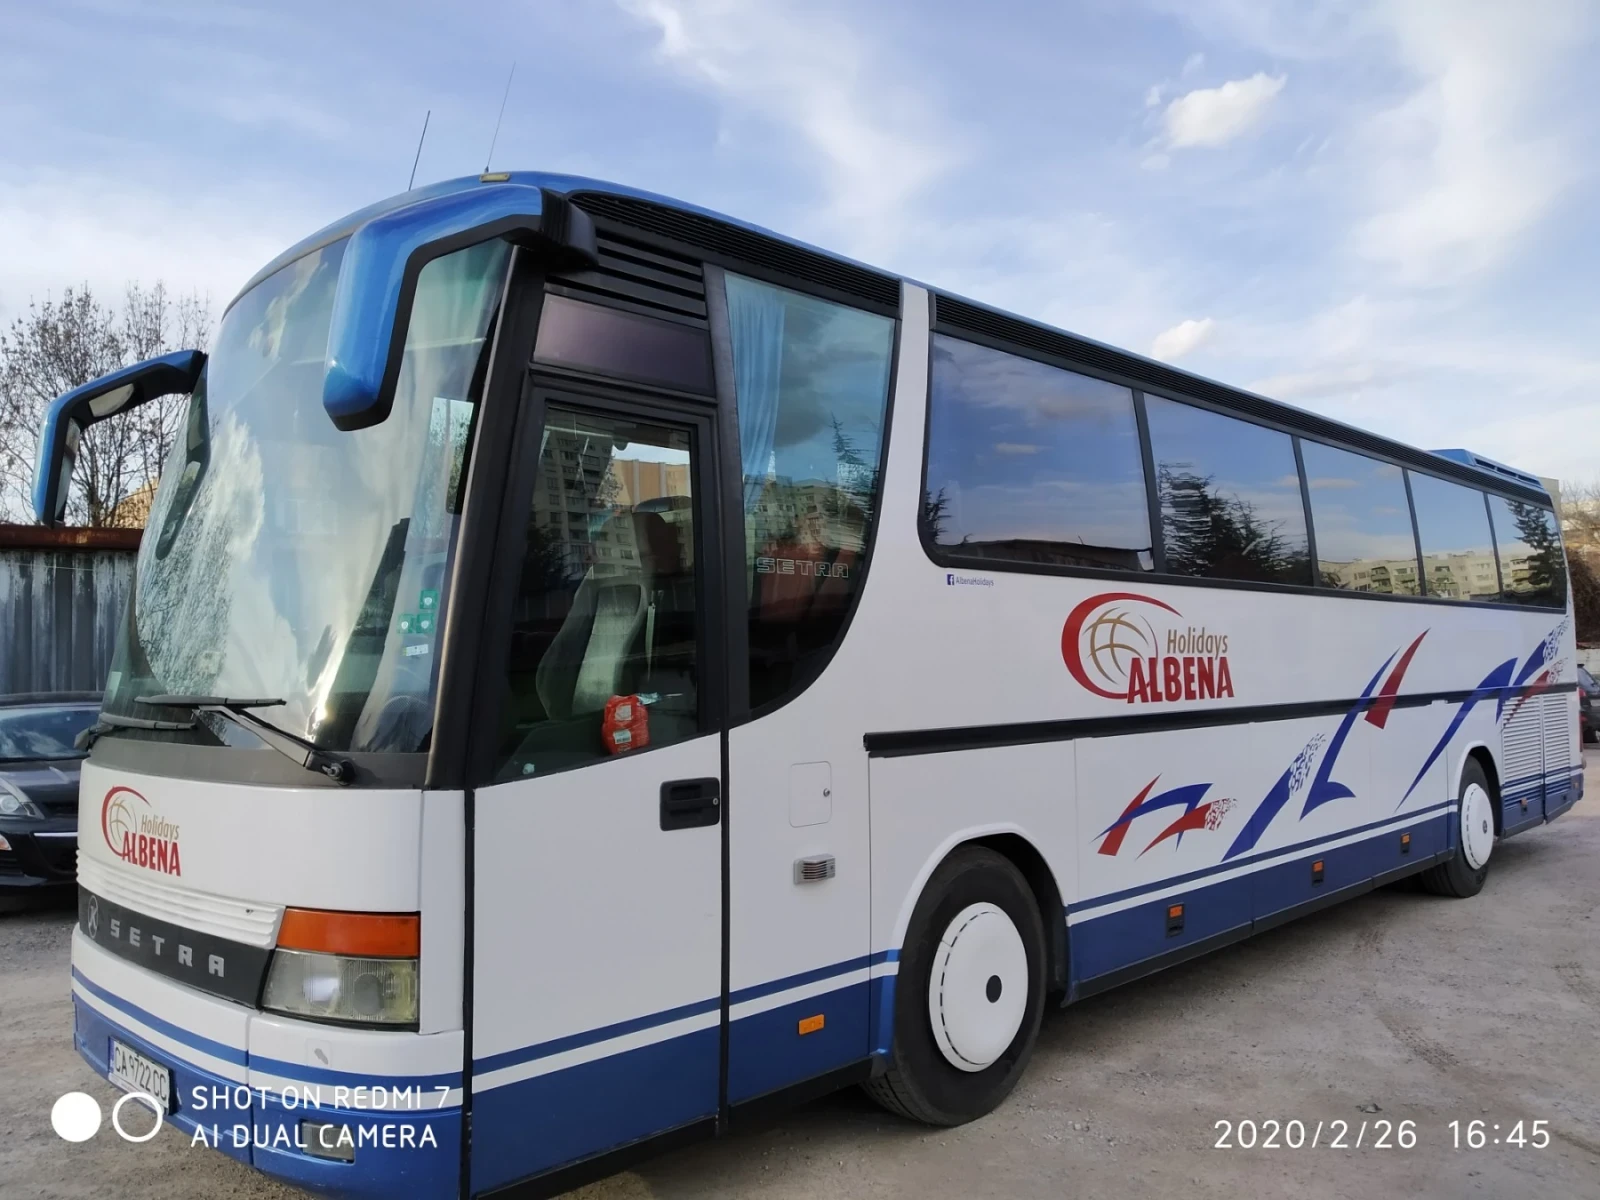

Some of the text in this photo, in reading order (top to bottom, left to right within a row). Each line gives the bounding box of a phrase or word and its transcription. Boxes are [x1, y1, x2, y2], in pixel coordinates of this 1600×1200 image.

[756, 557, 849, 578] SETRA
[956, 576, 994, 587] AlbenaHolidays
[1166, 626, 1229, 660] Holidays
[1127, 656, 1235, 704] ALBENA
[140, 814, 180, 845] Holidays
[121, 830, 182, 878] ALBENA
[110, 918, 225, 978] SETRA
